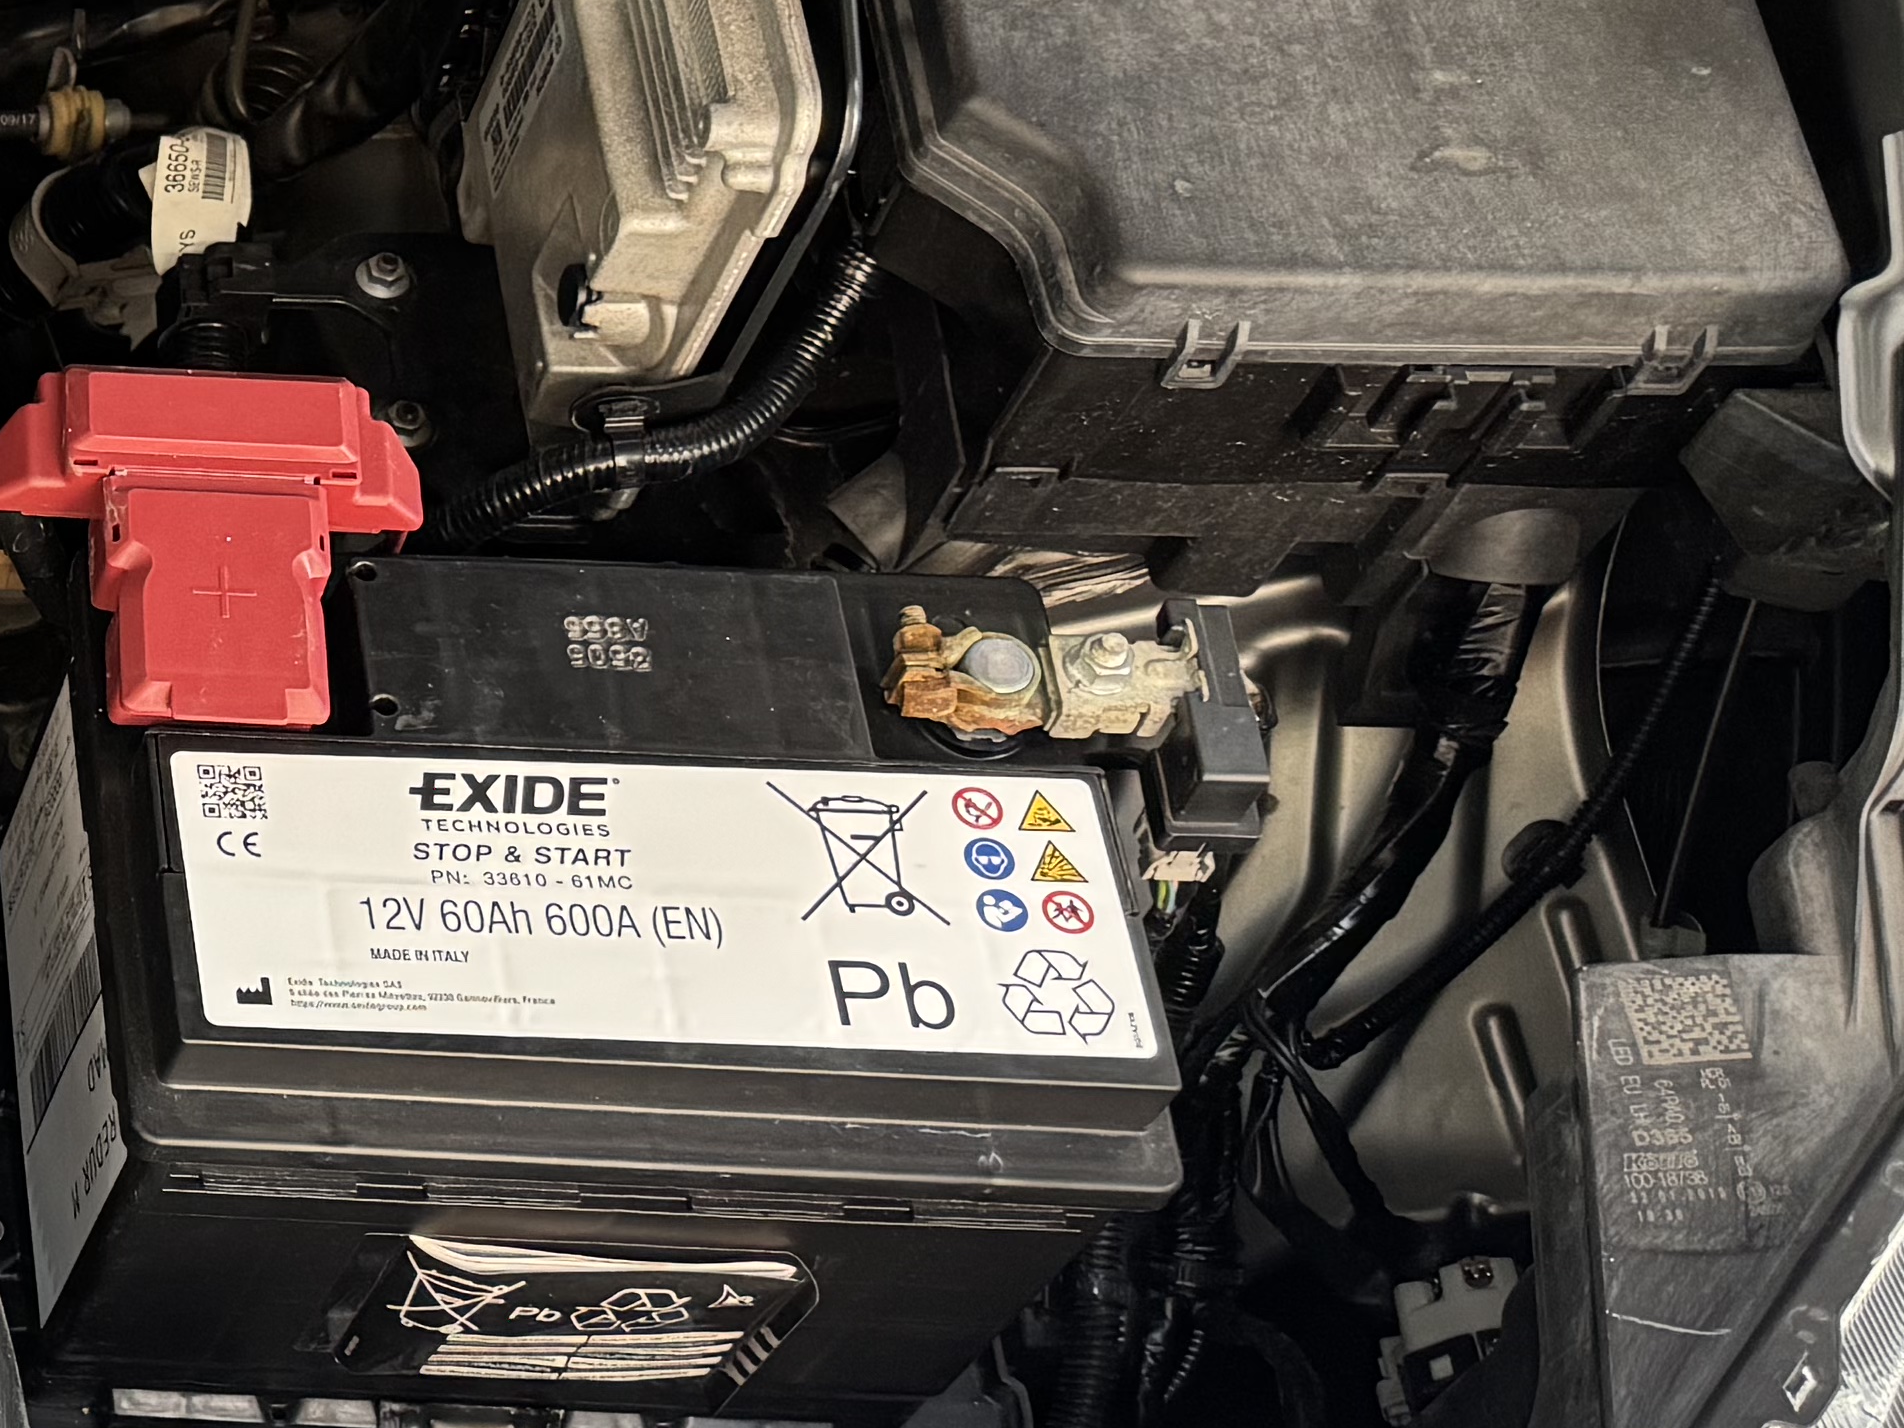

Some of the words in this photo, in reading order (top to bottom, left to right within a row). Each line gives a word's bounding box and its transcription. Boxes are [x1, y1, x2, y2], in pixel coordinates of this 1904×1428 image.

[408, 773, 608, 817] EXIDE
[420, 819, 611, 837] TECHNOLOGIES
[413, 843, 493, 863] STOP
[504, 845, 522, 863] &
[534, 847, 632, 867] START
[431, 869, 468, 884] PN:
[483, 871, 547, 888] 33610
[571, 873, 633, 890] 61MC
[360, 897, 425, 931] 12V
[440, 899, 533, 935] 60Ah
[545, 902, 641, 939] 600A
[651, 905, 724, 948] (EN)
[371, 948, 412, 961] MADE
[415, 949, 430, 962] IN
[433, 949, 469, 963] ITALY
[828, 959, 955, 1030] Pb
[1608, 1038, 1634, 1066] LED
[1621, 1075, 1642, 1095] EU
[509, 1305, 562, 1323] Pb
